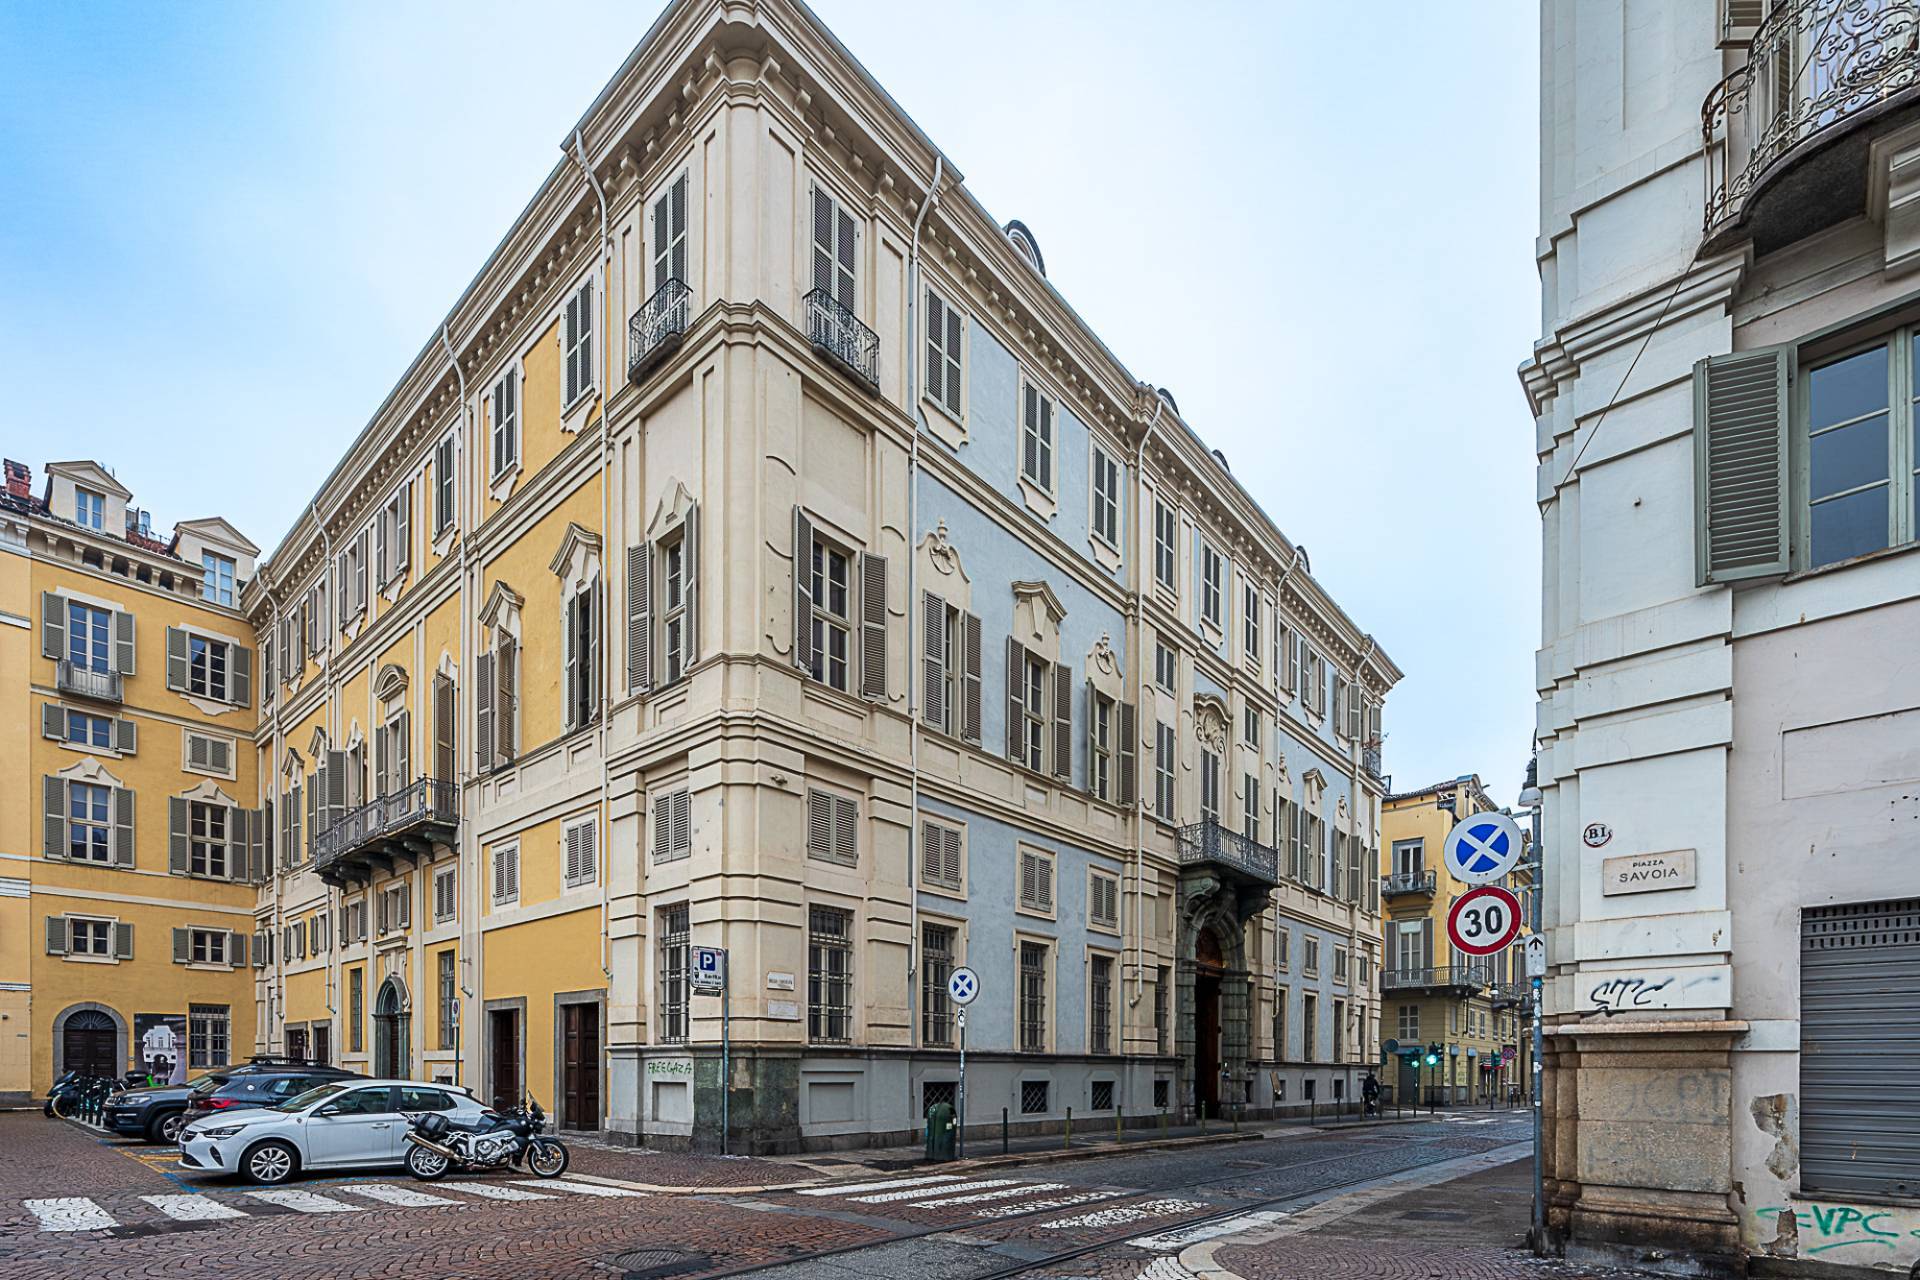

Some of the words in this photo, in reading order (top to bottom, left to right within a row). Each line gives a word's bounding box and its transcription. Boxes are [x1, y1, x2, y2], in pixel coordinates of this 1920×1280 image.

[1632, 859, 1665, 868] PIAZZA
[1618, 867, 1679, 883] SAVOIA
[1464, 905, 1503, 938] 30
[703, 953, 713, 969] P
